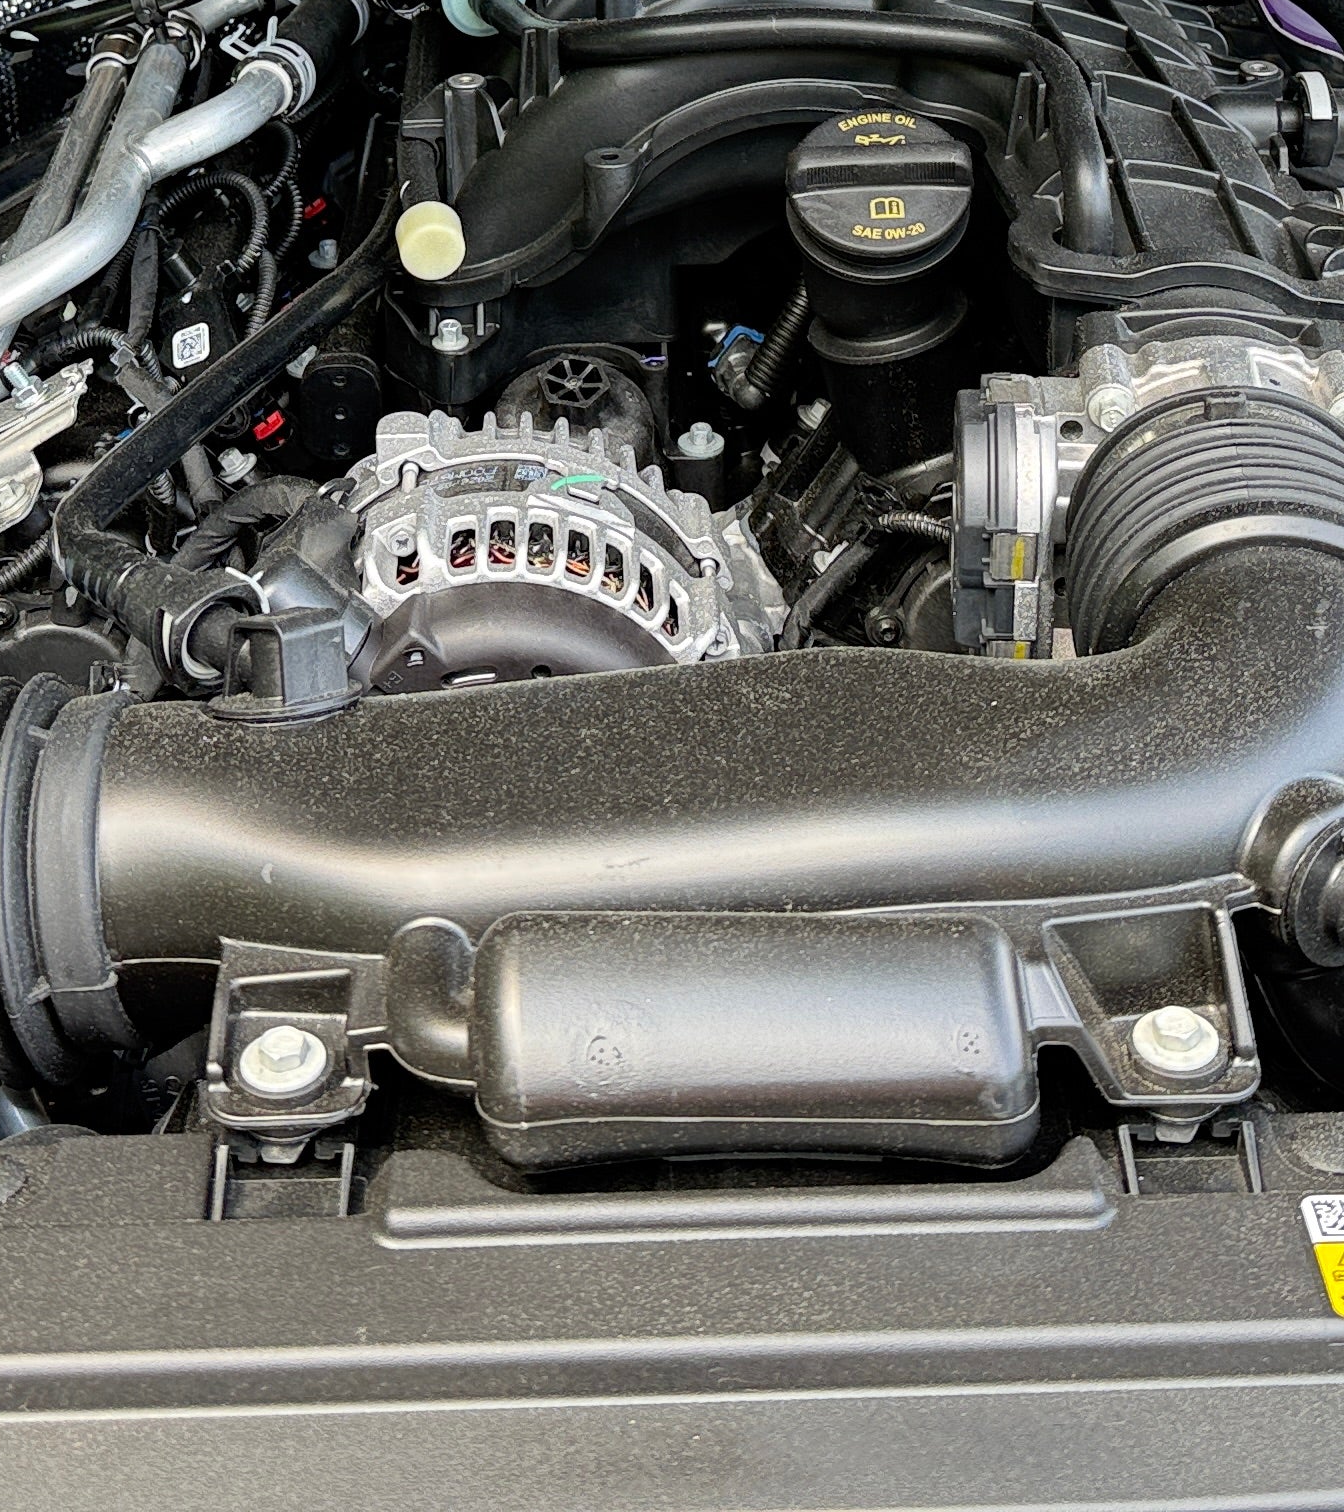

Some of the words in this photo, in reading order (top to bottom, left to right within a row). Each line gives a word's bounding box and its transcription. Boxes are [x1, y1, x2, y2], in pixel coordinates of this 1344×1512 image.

[838, 112, 893, 132] ENGINE
[895, 113, 918, 130] OIL
[851, 224, 882, 240] SAE
[884, 222, 926, 241] 0W-20
